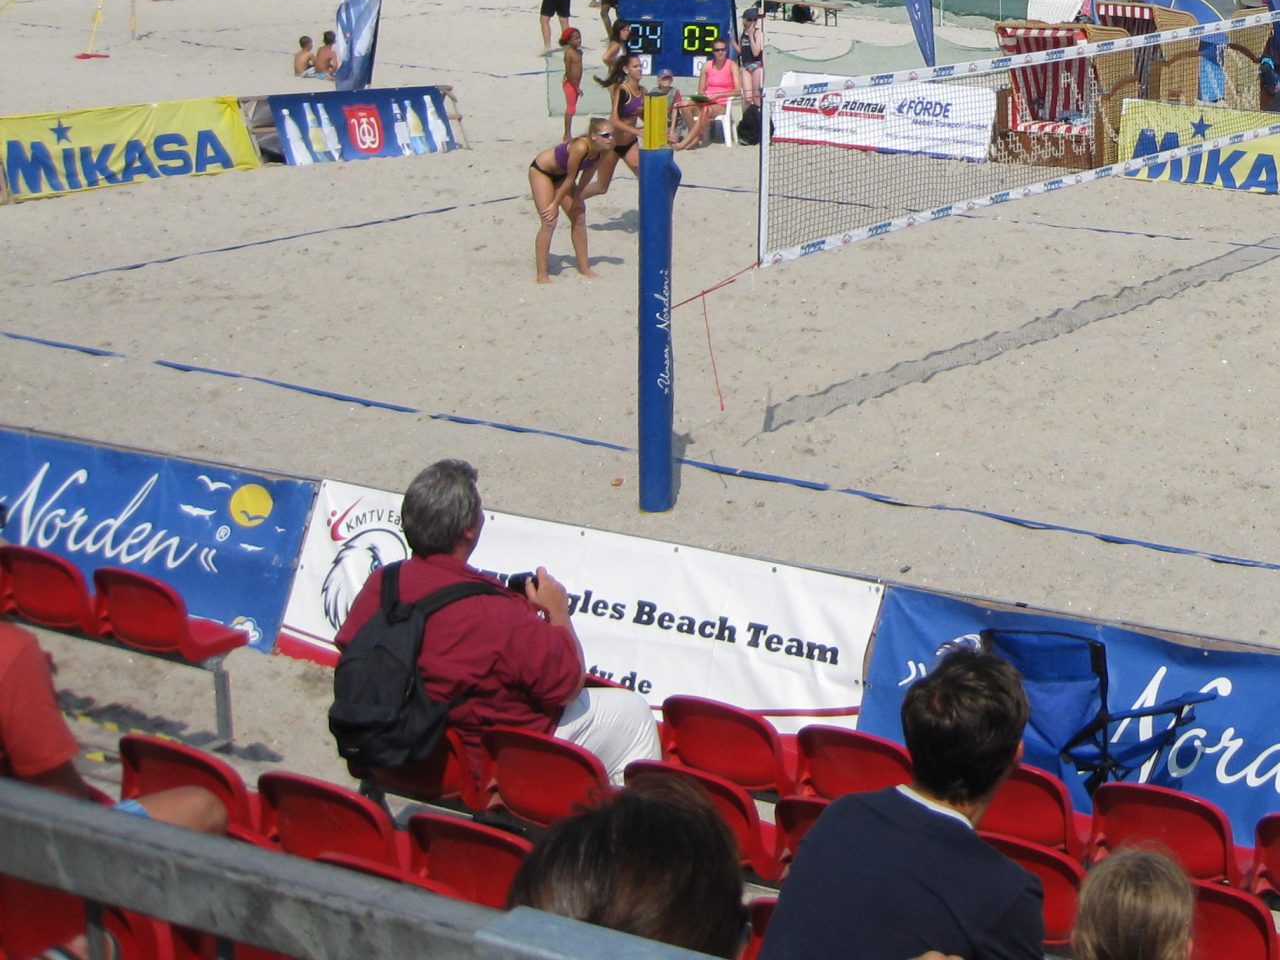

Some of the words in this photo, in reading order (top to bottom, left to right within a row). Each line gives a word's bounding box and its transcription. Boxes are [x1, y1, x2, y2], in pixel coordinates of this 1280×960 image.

[906, 96, 953, 119] FÖRDE
[346, 508, 385, 533] KMTV
[567, 589, 627, 620] gles
[632, 599, 737, 643] Beach
[747, 622, 840, 665] Team
